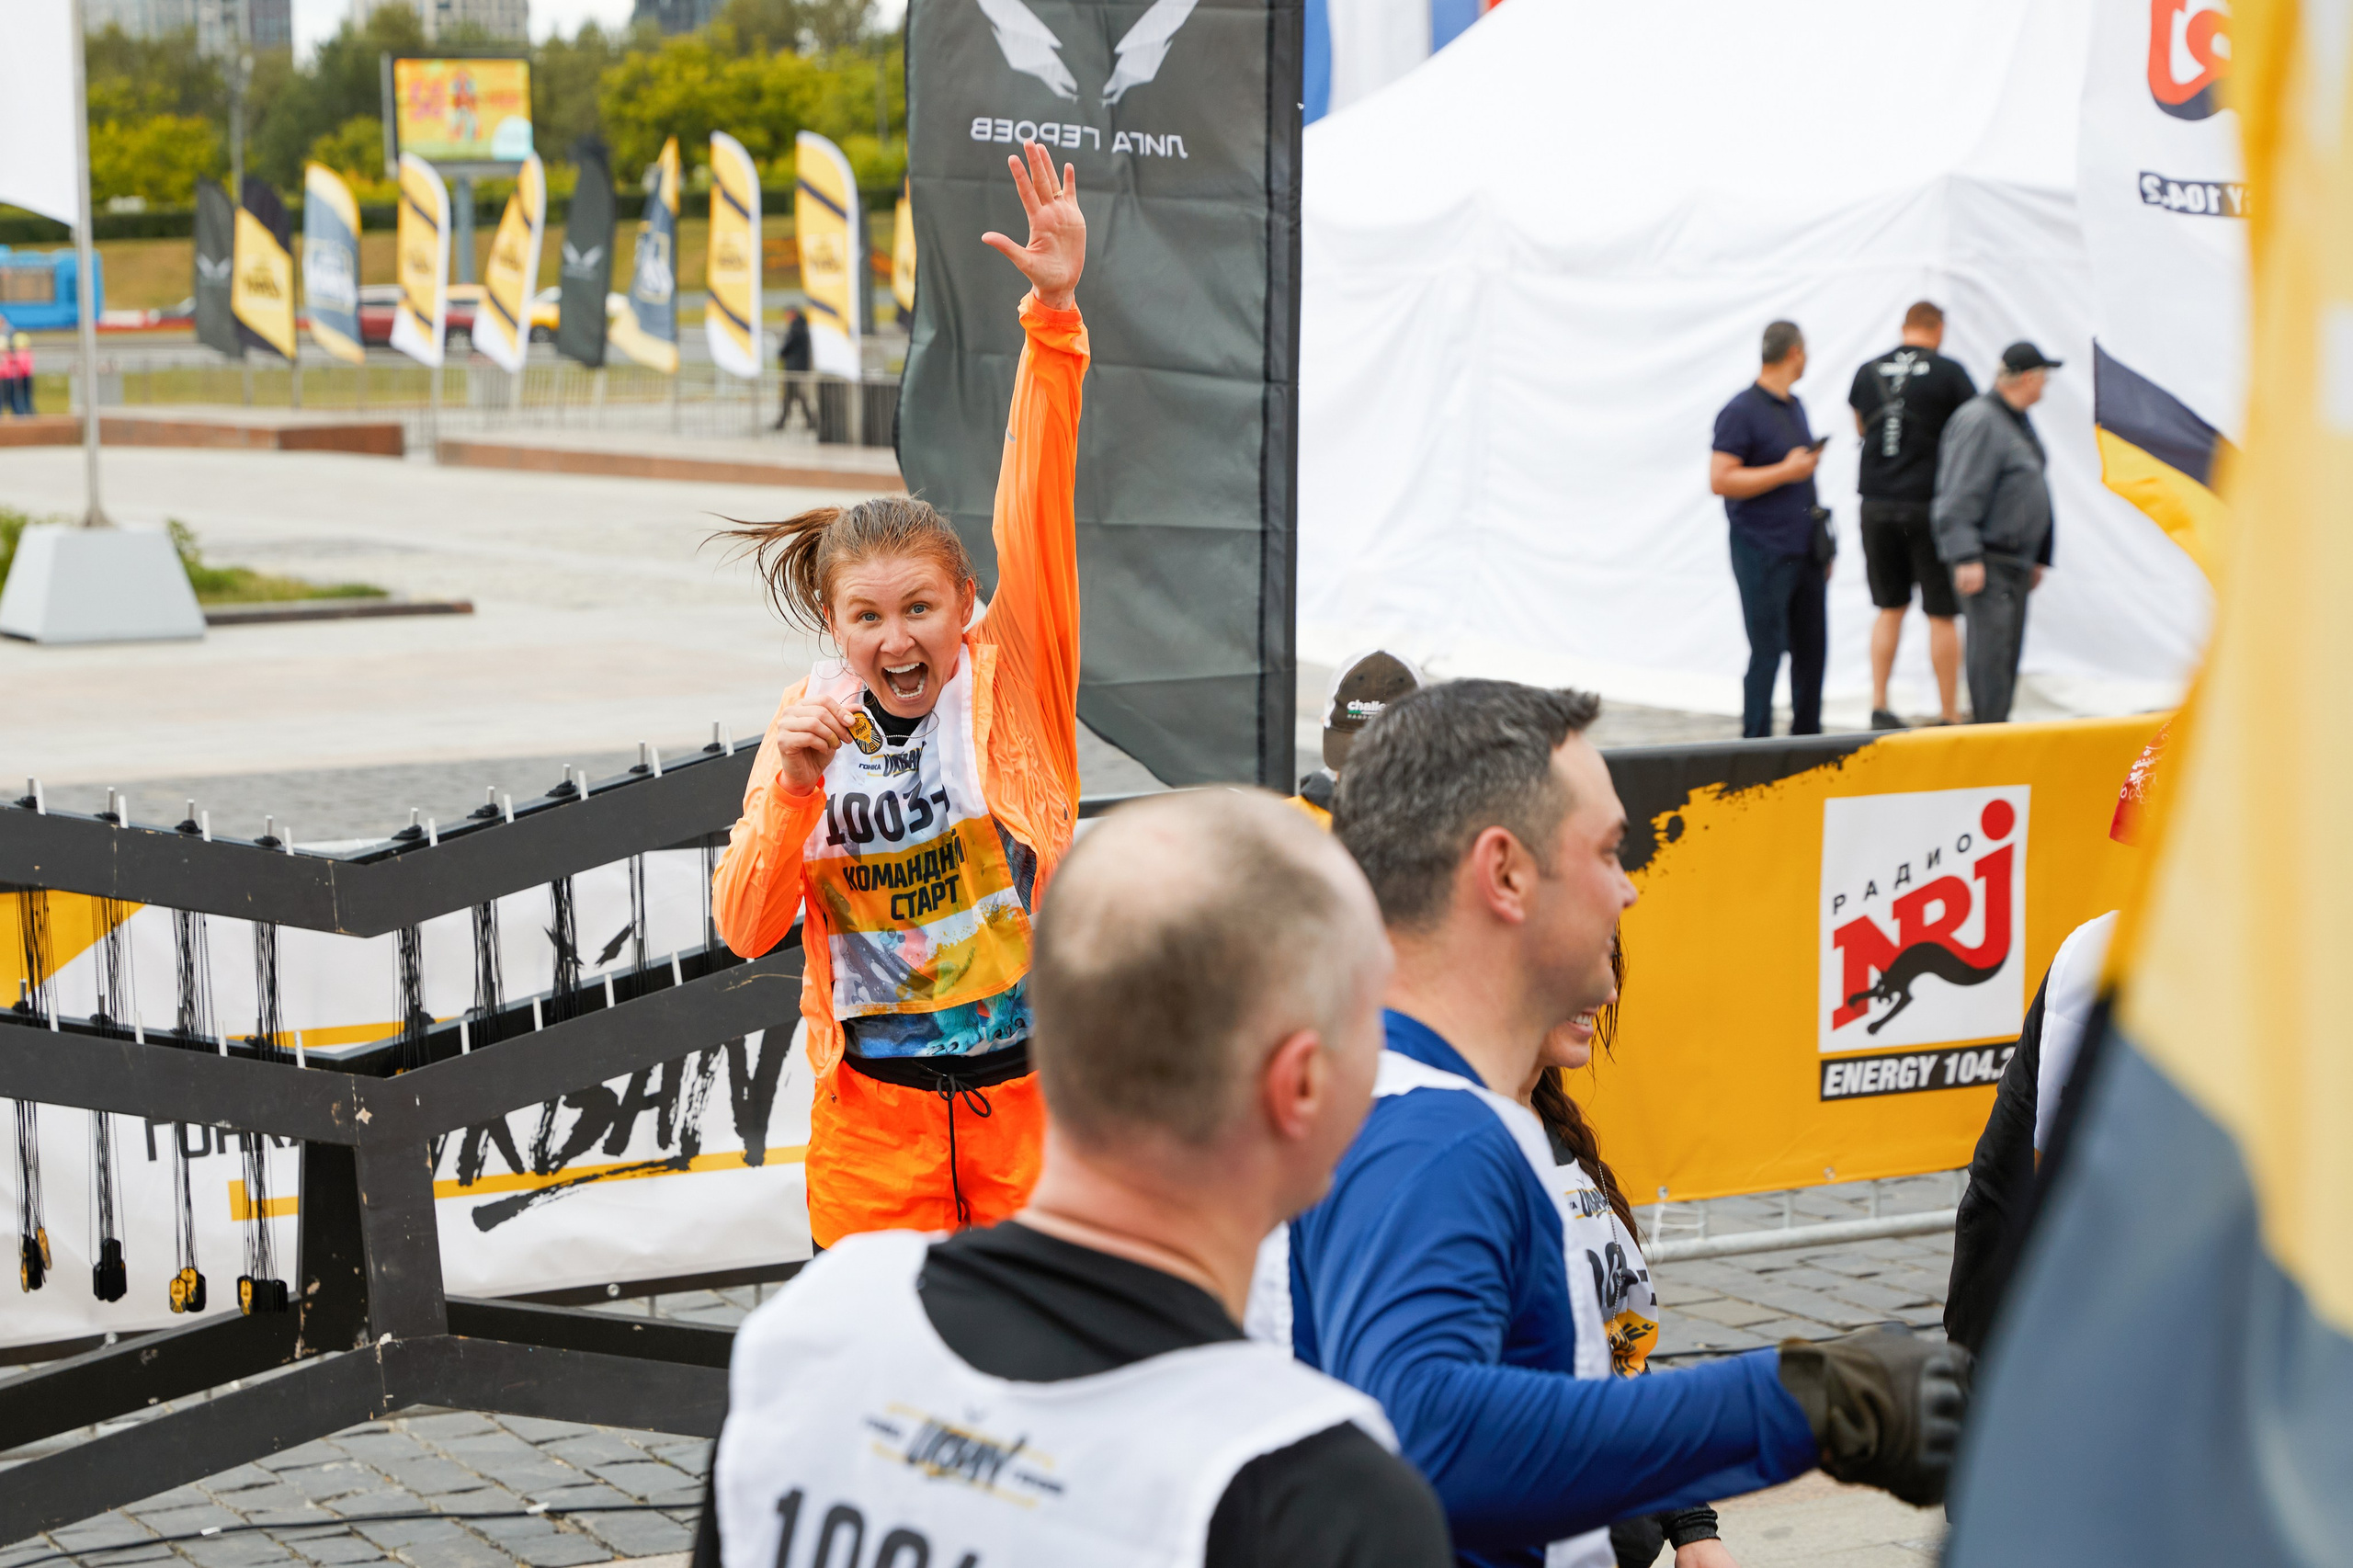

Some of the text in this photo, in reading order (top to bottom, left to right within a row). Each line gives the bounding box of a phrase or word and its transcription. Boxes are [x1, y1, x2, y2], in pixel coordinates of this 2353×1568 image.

[891, 874, 960, 921] СТАРТ
[1833, 833, 1972, 915] РАДИО
[1823, 1054, 1939, 1096] ENERGY
